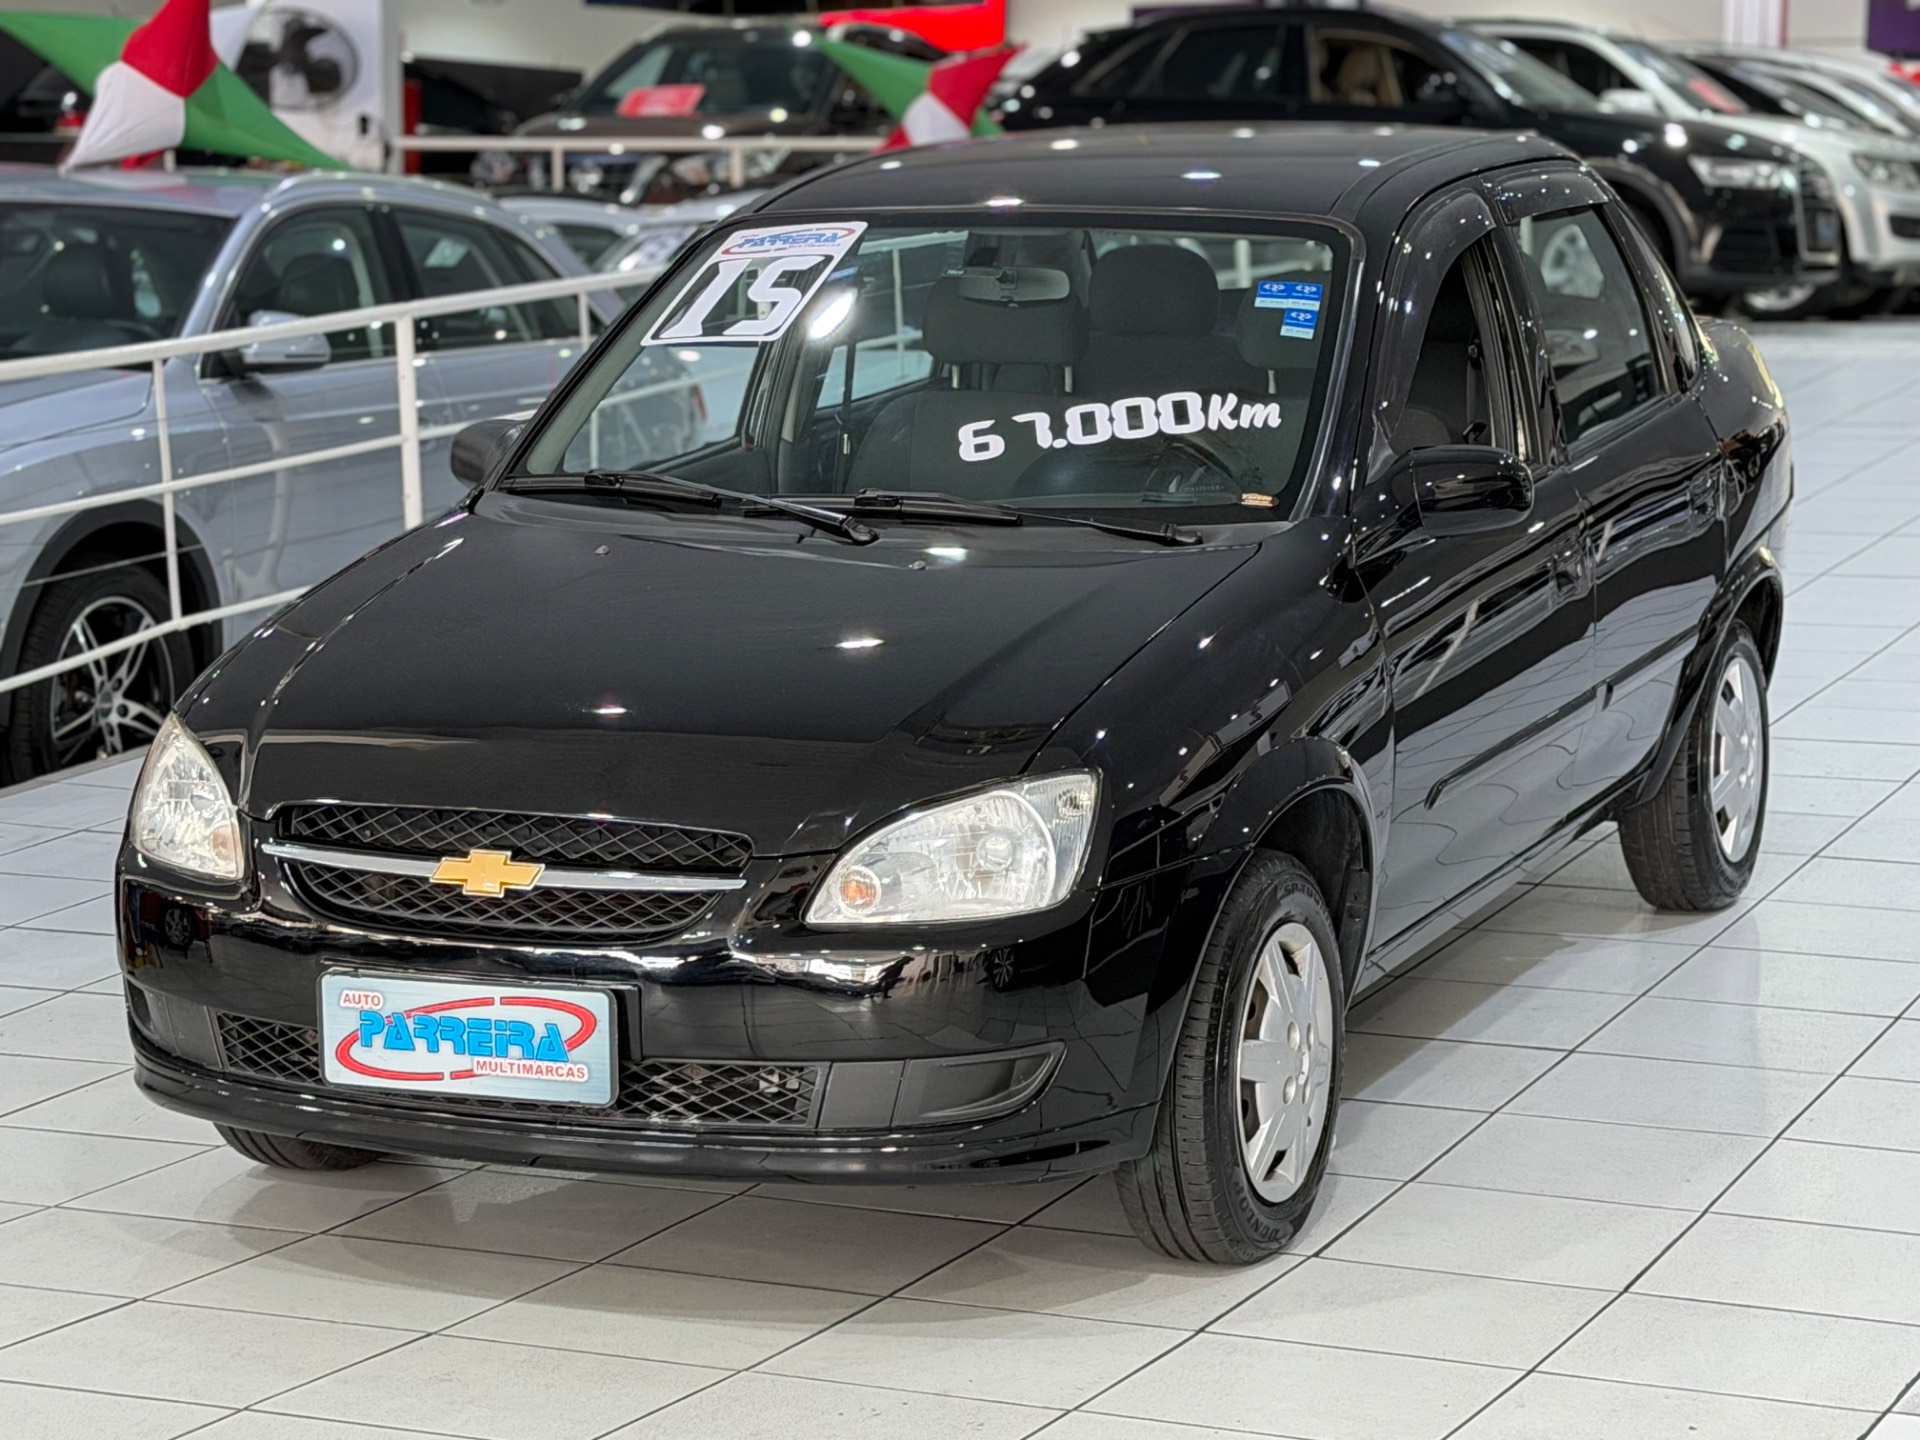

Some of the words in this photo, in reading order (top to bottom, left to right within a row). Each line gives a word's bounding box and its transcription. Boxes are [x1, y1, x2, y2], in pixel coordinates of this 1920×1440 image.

[659, 255, 827, 338] 15
[343, 991, 381, 1007] AUTO
[359, 1009, 570, 1063] PARREIRA
[476, 1059, 586, 1079] MULTIMARCAS
